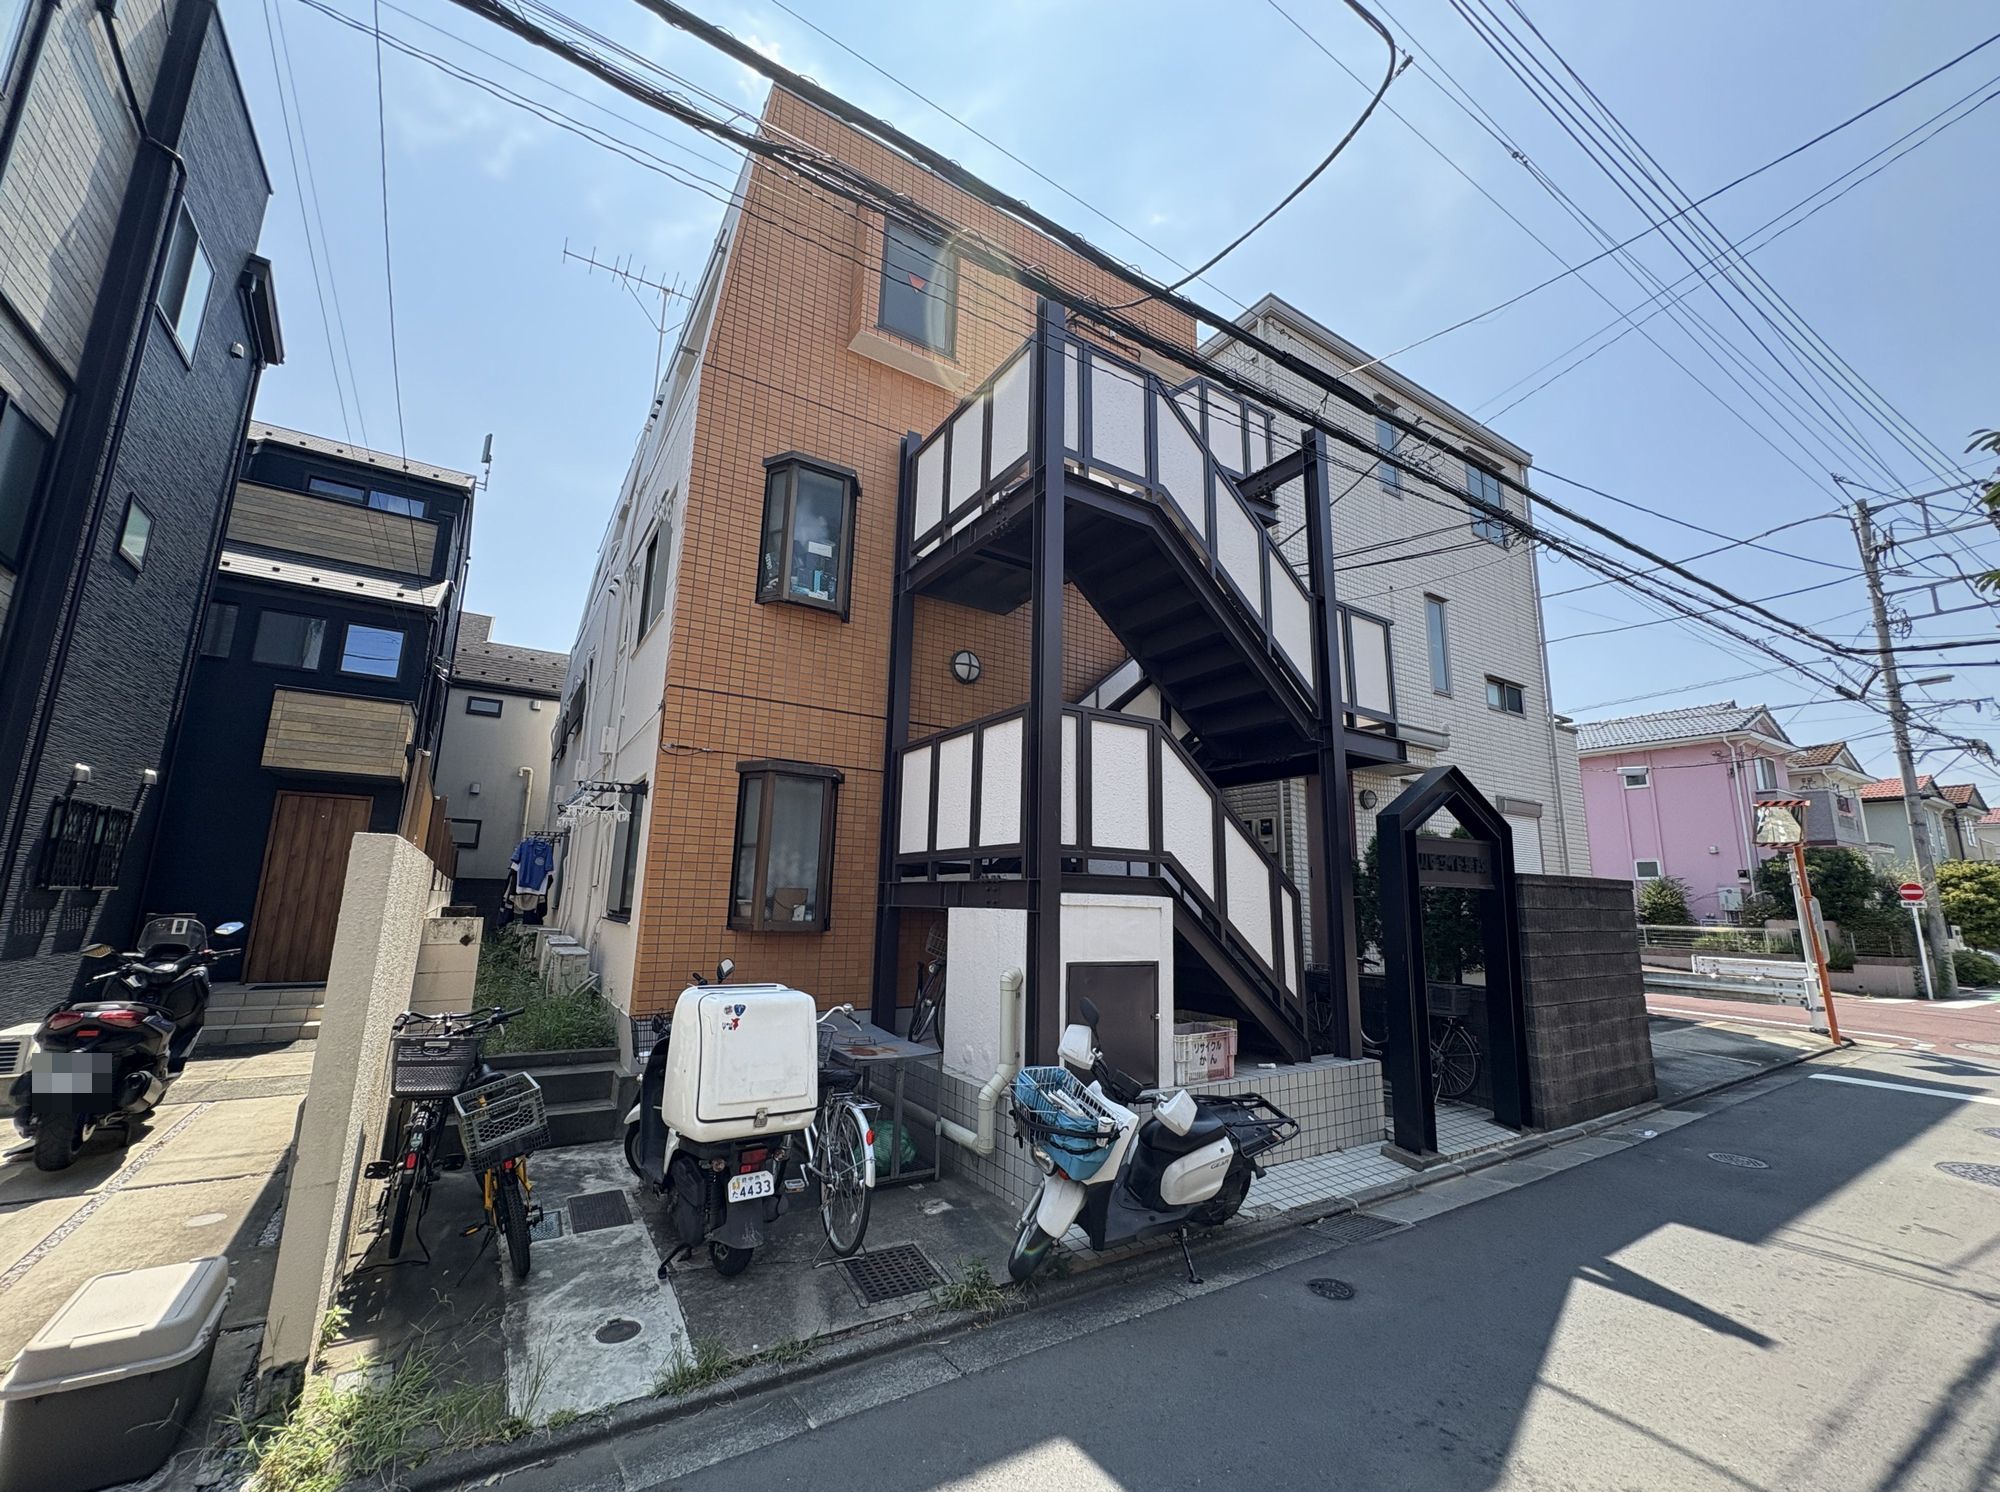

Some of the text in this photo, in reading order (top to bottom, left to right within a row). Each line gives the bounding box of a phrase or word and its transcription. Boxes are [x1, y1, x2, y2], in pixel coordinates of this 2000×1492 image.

[1194, 1041, 1221, 1054] リサイクル
[1200, 1054, 1217, 1066] かん
[740, 1180, 770, 1198] 4433
